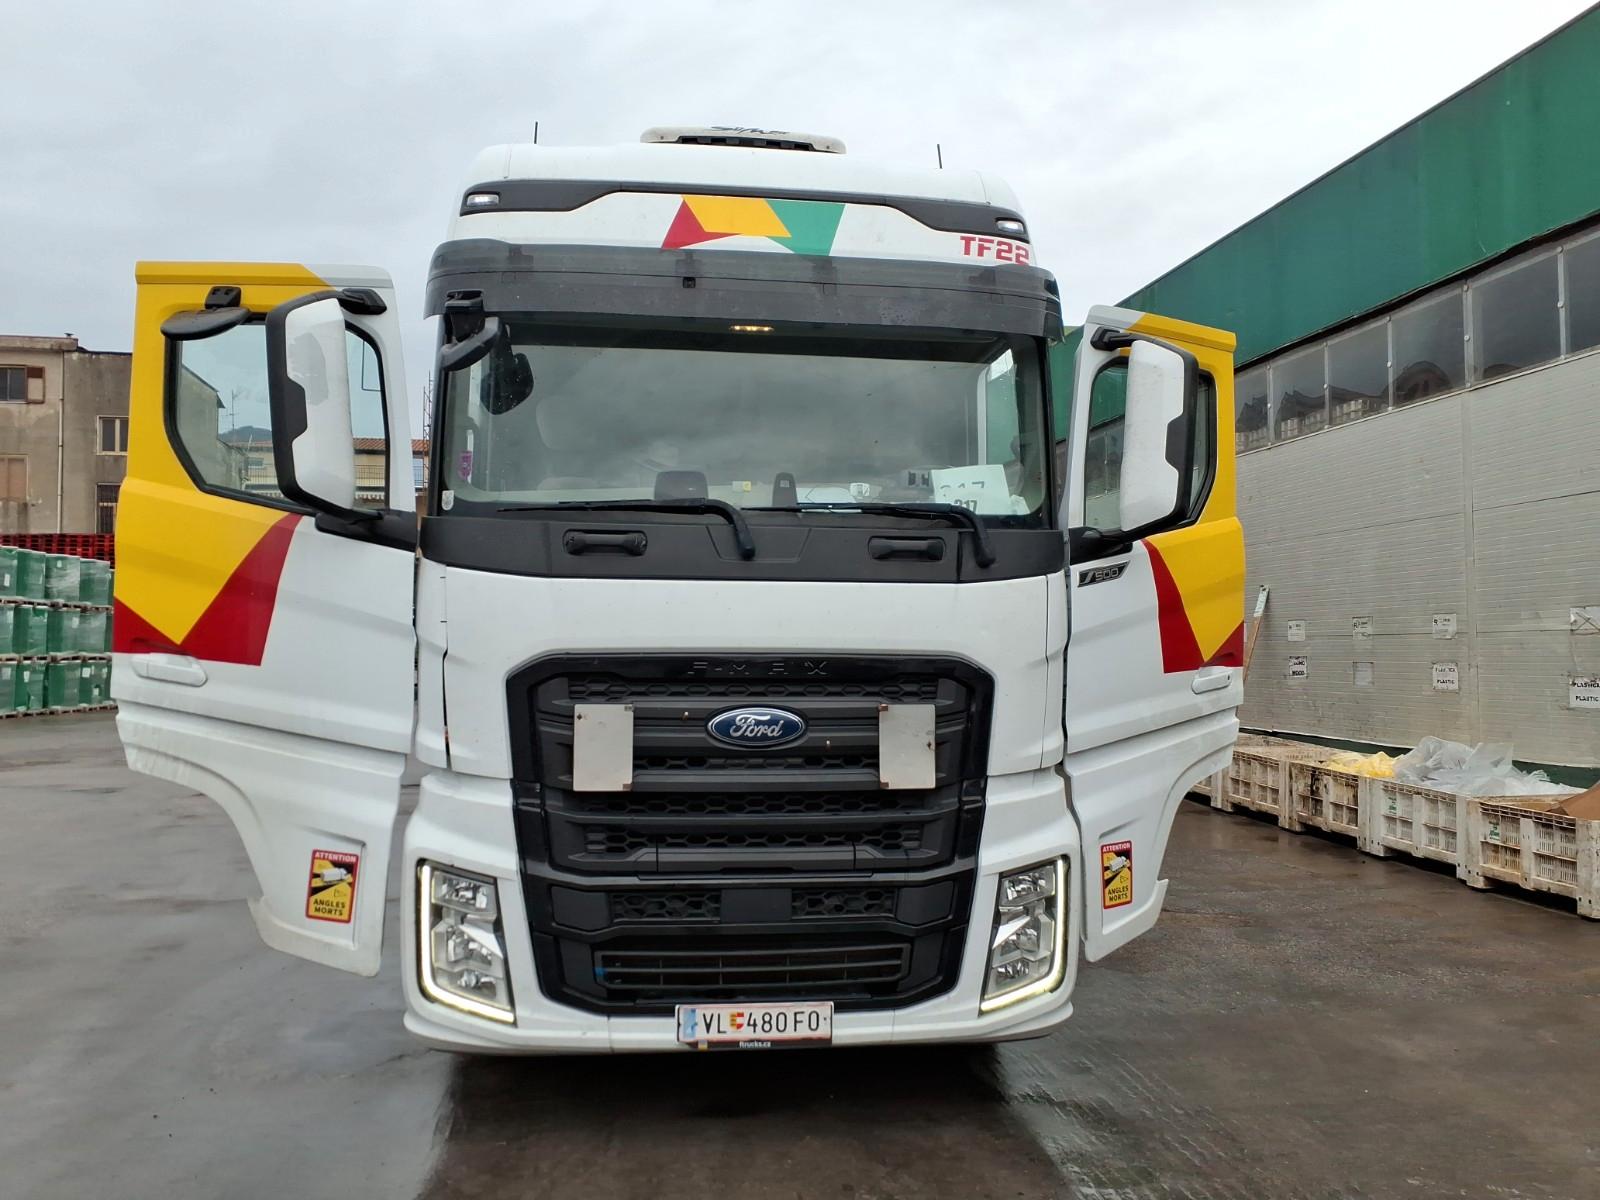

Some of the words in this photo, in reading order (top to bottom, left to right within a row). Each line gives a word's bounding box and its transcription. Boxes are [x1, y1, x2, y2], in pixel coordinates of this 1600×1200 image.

[959, 235, 1030, 266] TF22
[687, 661, 828, 675] F-MAX
[729, 713, 785, 738] Ford
[1102, 842, 1131, 853] ATTENTION
[314, 851, 356, 862] ATTENTION
[1107, 885, 1129, 895] ANGLES
[1108, 893, 1128, 902] MORTS
[313, 898, 346, 909] ANGLES
[314, 906, 344, 916] MORTS
[702, 1012, 727, 1034] VL
